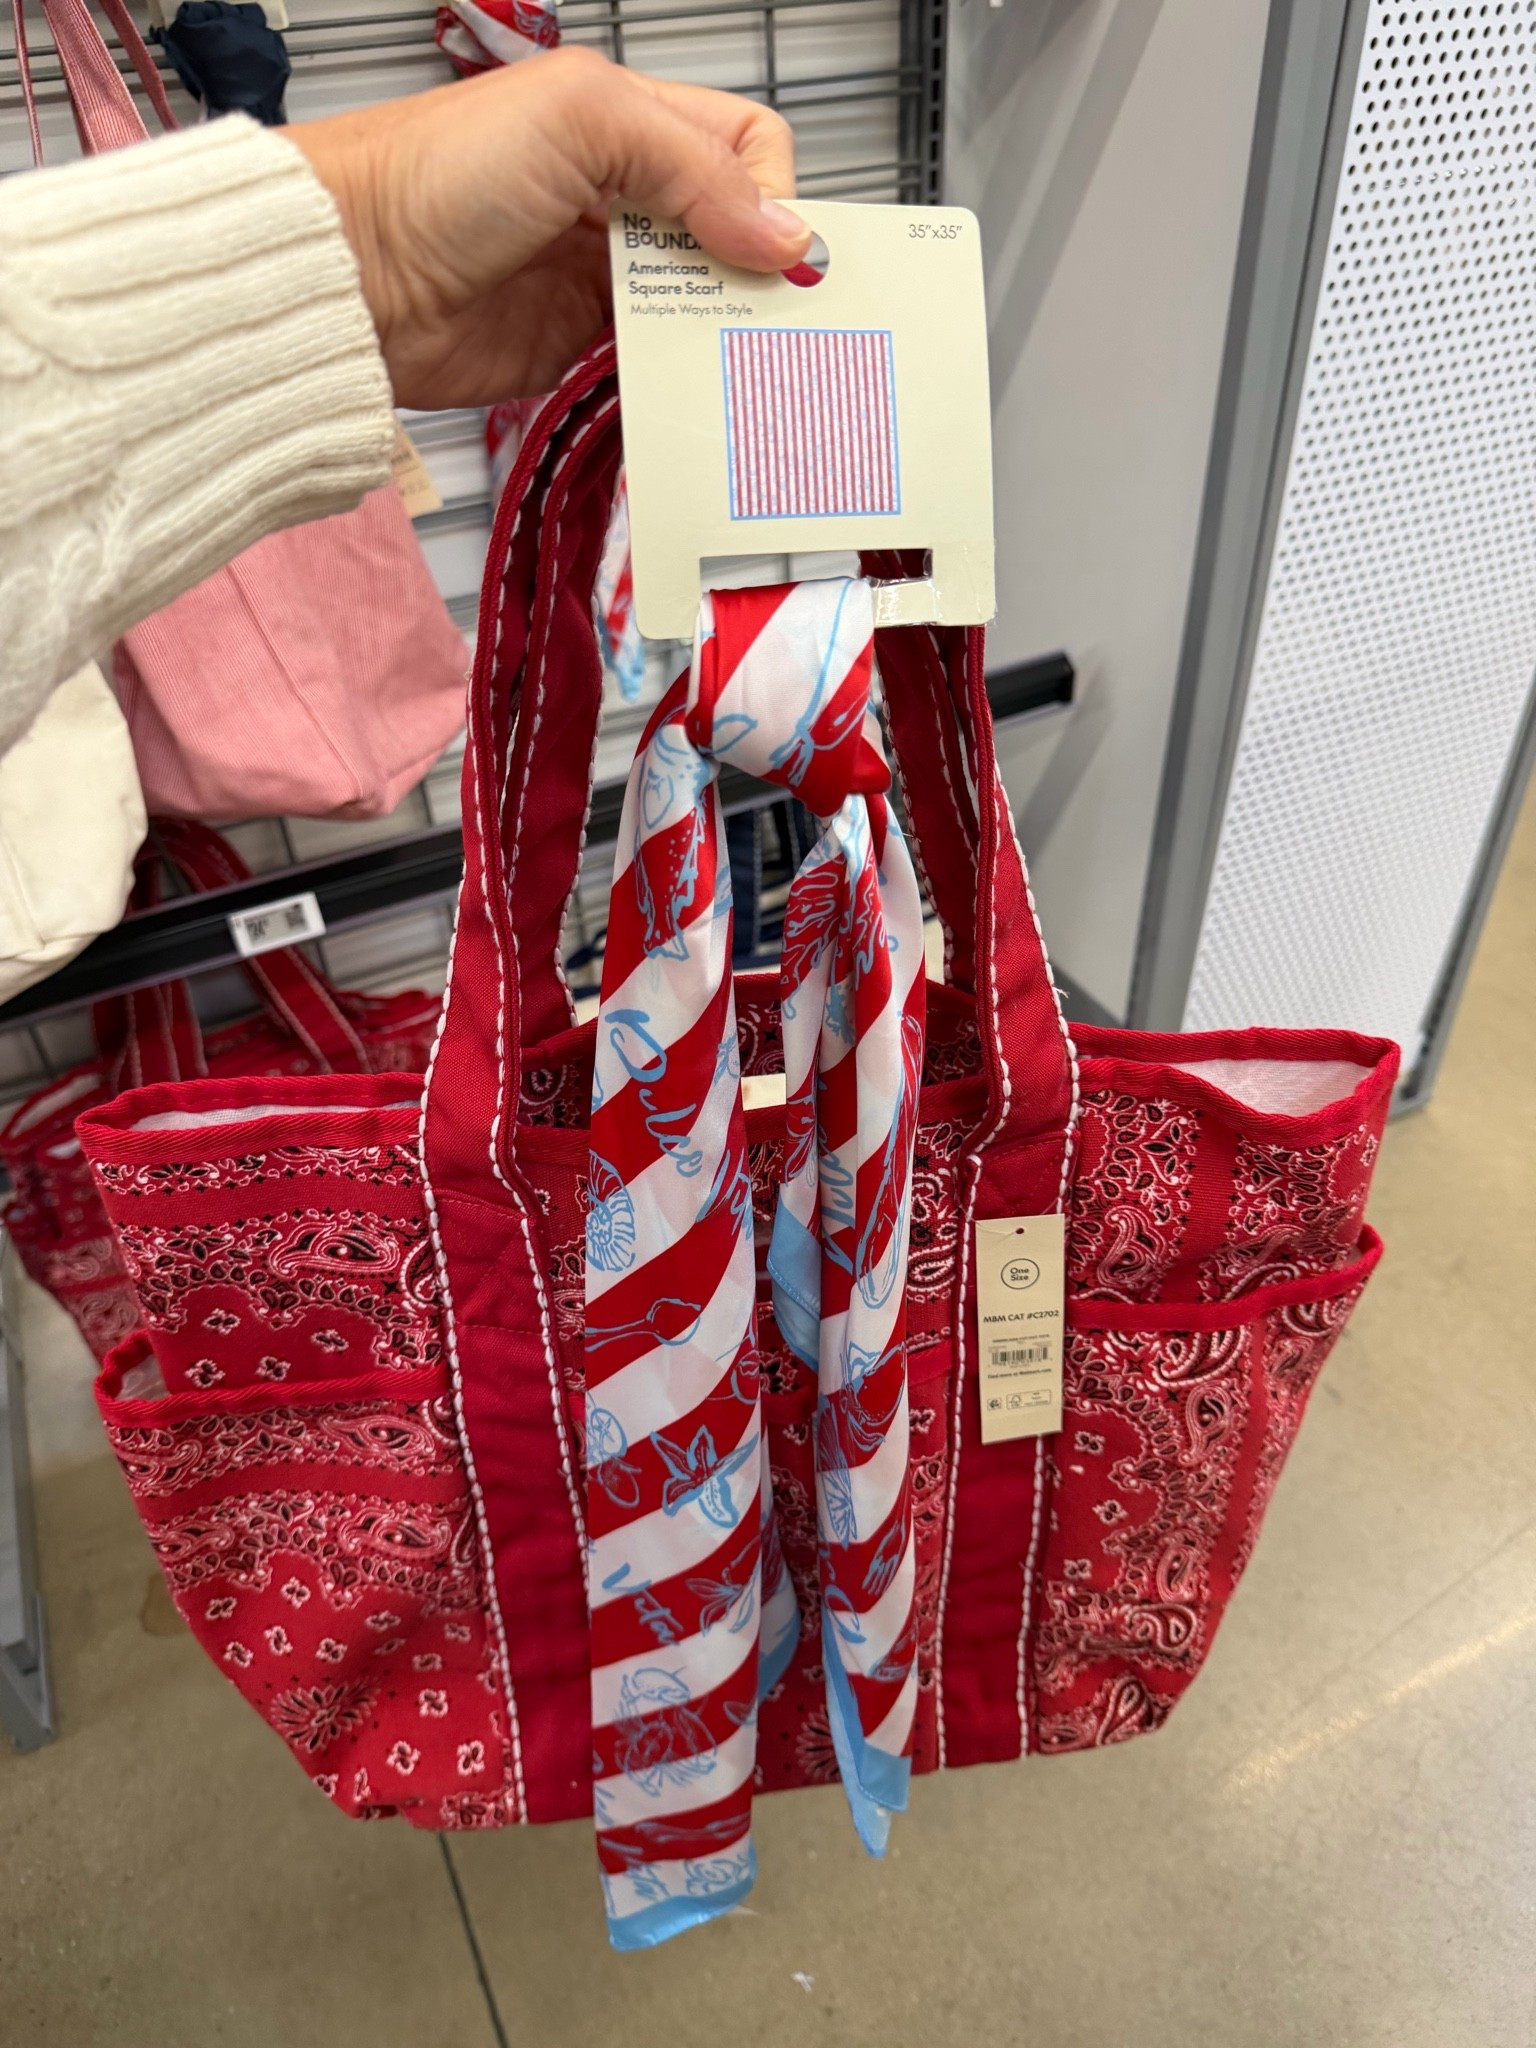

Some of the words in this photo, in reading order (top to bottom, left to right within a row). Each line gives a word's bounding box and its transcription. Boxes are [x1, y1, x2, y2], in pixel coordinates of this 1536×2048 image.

[625, 231, 702, 250] BOUND
[628, 261, 709, 275] Americana
[628, 280, 682, 299] Square
[685, 280, 724, 295] Scarf
[630, 303, 676, 318] Multiple
[679, 303, 711, 318] Ways
[712, 304, 724, 316] to
[725, 303, 753, 318] Style
[1010, 1274, 1029, 1282] Size
[983, 1314, 1006, 1323] MBM
[1007, 1313, 1025, 1321] CAT
[1027, 1310, 1059, 1320] #C2702
